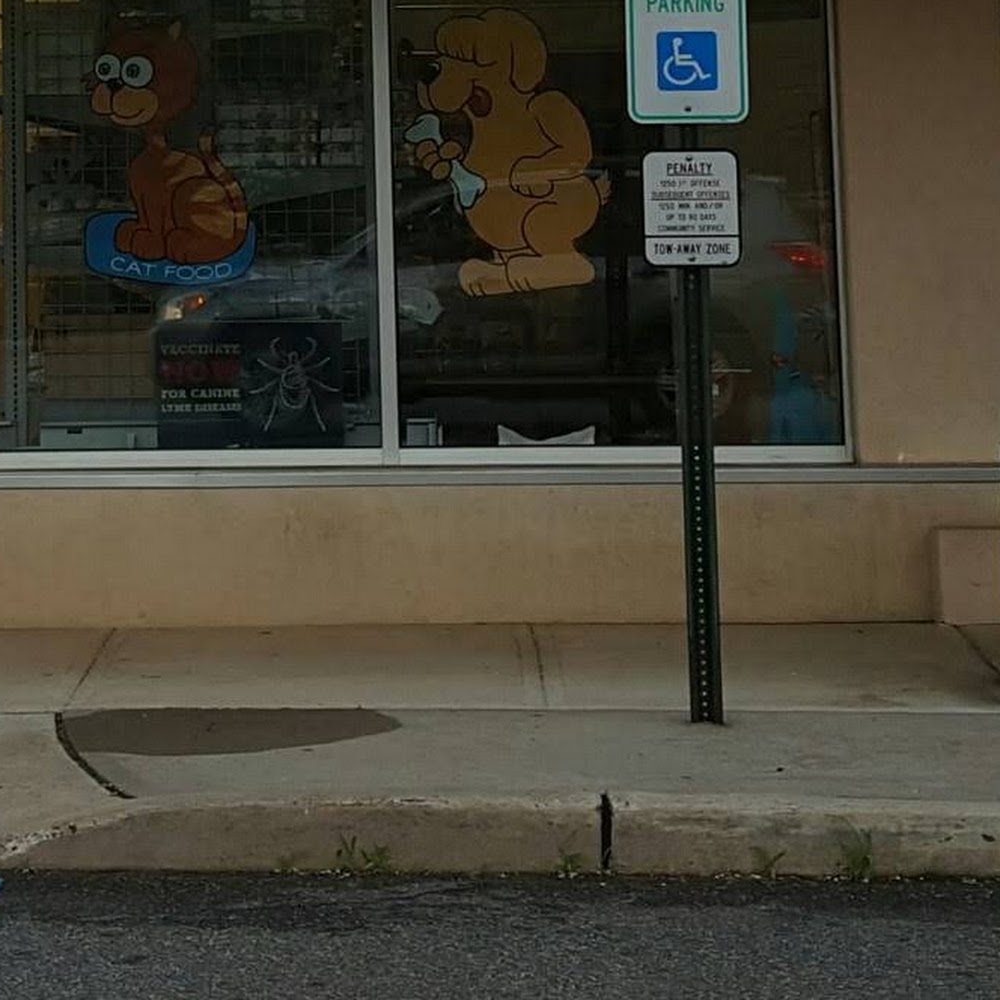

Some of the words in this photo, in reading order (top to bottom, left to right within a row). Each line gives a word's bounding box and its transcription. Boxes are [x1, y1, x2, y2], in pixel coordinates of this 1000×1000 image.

[666, 163, 713, 175] PENALTY
[654, 243, 701, 255] TOW-AWAY
[706, 243, 732, 255] ZONE
[110, 256, 157, 276] CAT
[164, 262, 233, 280] FOOD
[161, 388, 187, 398] FOR
[190, 388, 241, 398] CANINE
